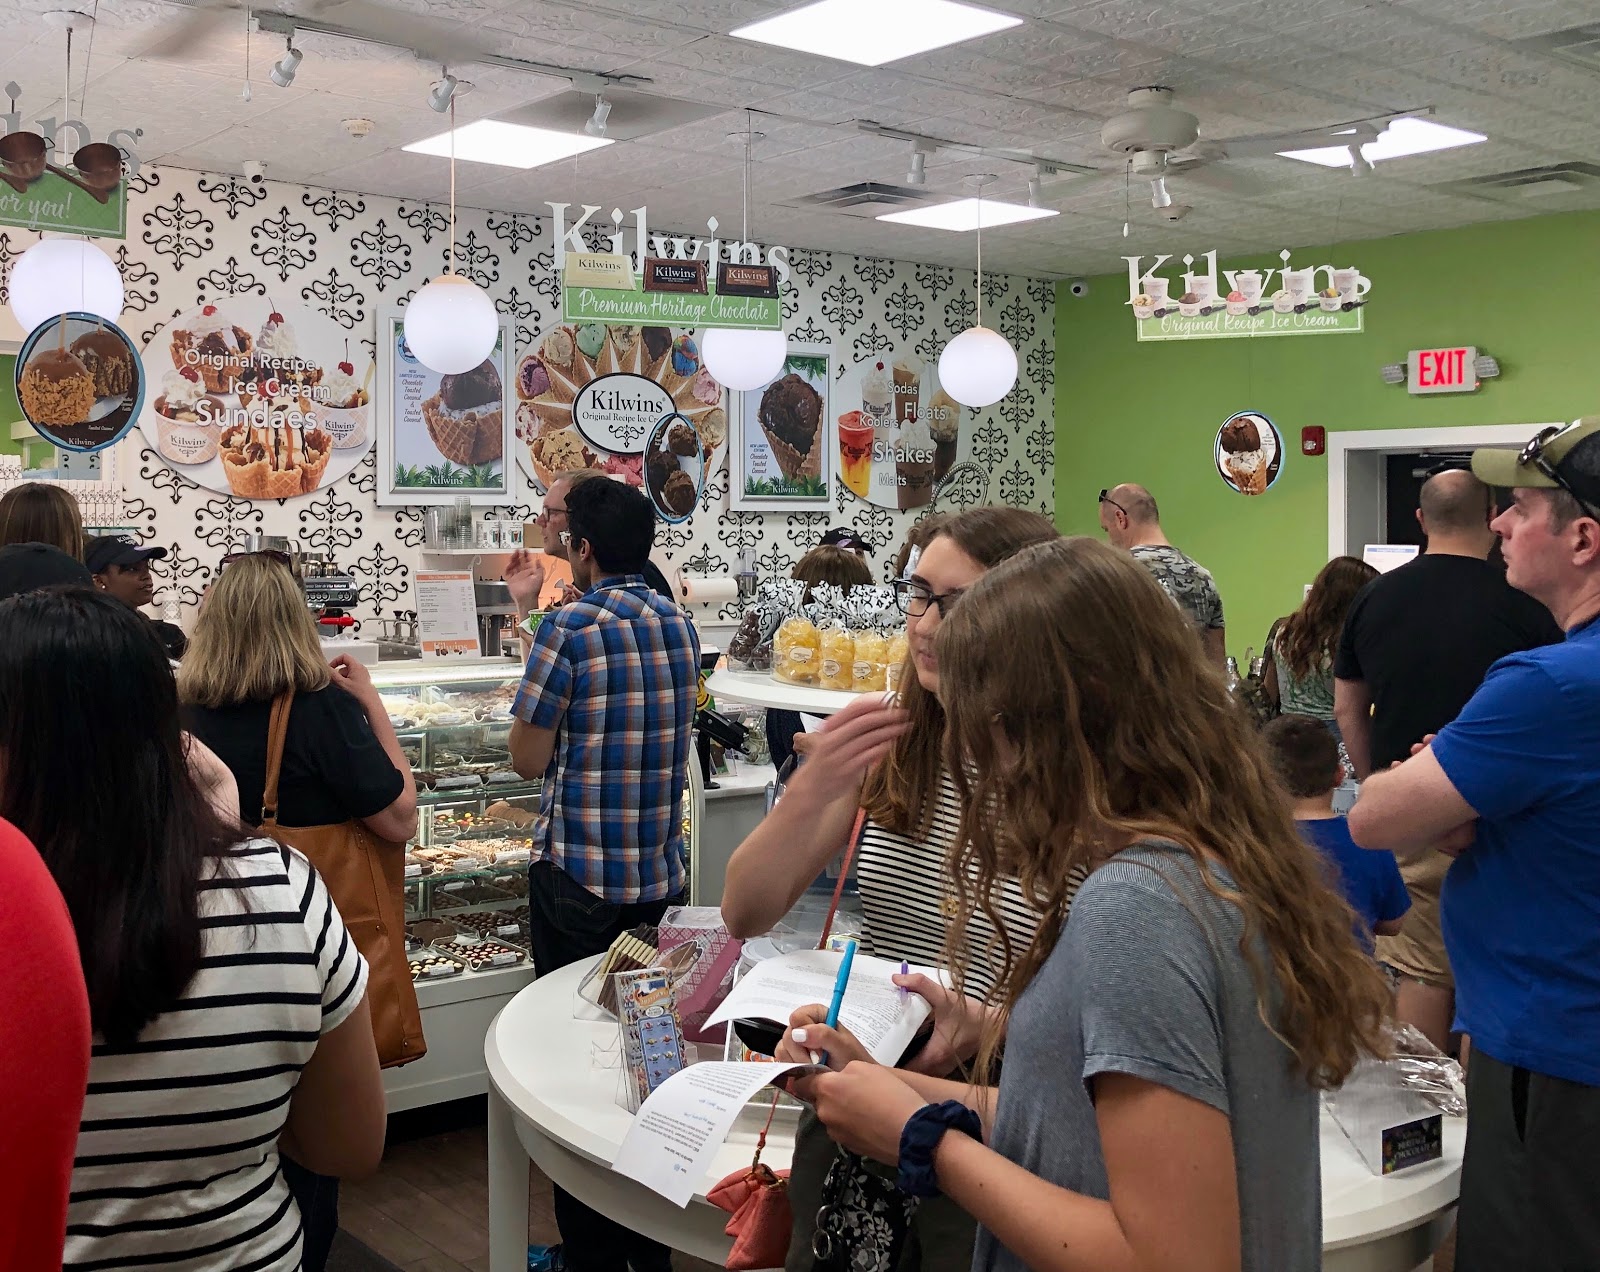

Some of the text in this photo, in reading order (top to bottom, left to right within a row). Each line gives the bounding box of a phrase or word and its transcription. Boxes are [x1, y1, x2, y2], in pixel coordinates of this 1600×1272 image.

[0, 191, 73, 228] or you!
[544, 201, 790, 285] Kilwins
[578, 258, 622, 270] Kilwins
[655, 265, 697, 279] Kilwins
[728, 269, 768, 281] Kilwins
[578, 288, 769, 325] Premium Heritage Chocolate
[1160, 311, 1340, 337] Original Recipe Ice Cream
[184, 348, 316, 373] Original Recipe
[1419, 349, 1467, 386] EXIT
[229, 376, 331, 399] Ice Cream
[887, 381, 918, 395] Sodas
[590, 389, 663, 413] Kilwins
[194, 400, 318, 430] Sundaes
[582, 411, 612, 421] Original
[613, 413, 636, 423] Recipe
[637, 414, 647, 422] Ice
[904, 401, 947, 420] Floats
[324, 419, 355, 430] Kilwins
[859, 414, 899, 428] Koolers
[68, 437, 96, 446] Kilwins
[170, 434, 207, 446] Kilwins
[873, 440, 934, 463] Shakes
[430, 475, 463, 485] Kilwins
[772, 484, 798, 493] Kilwins
